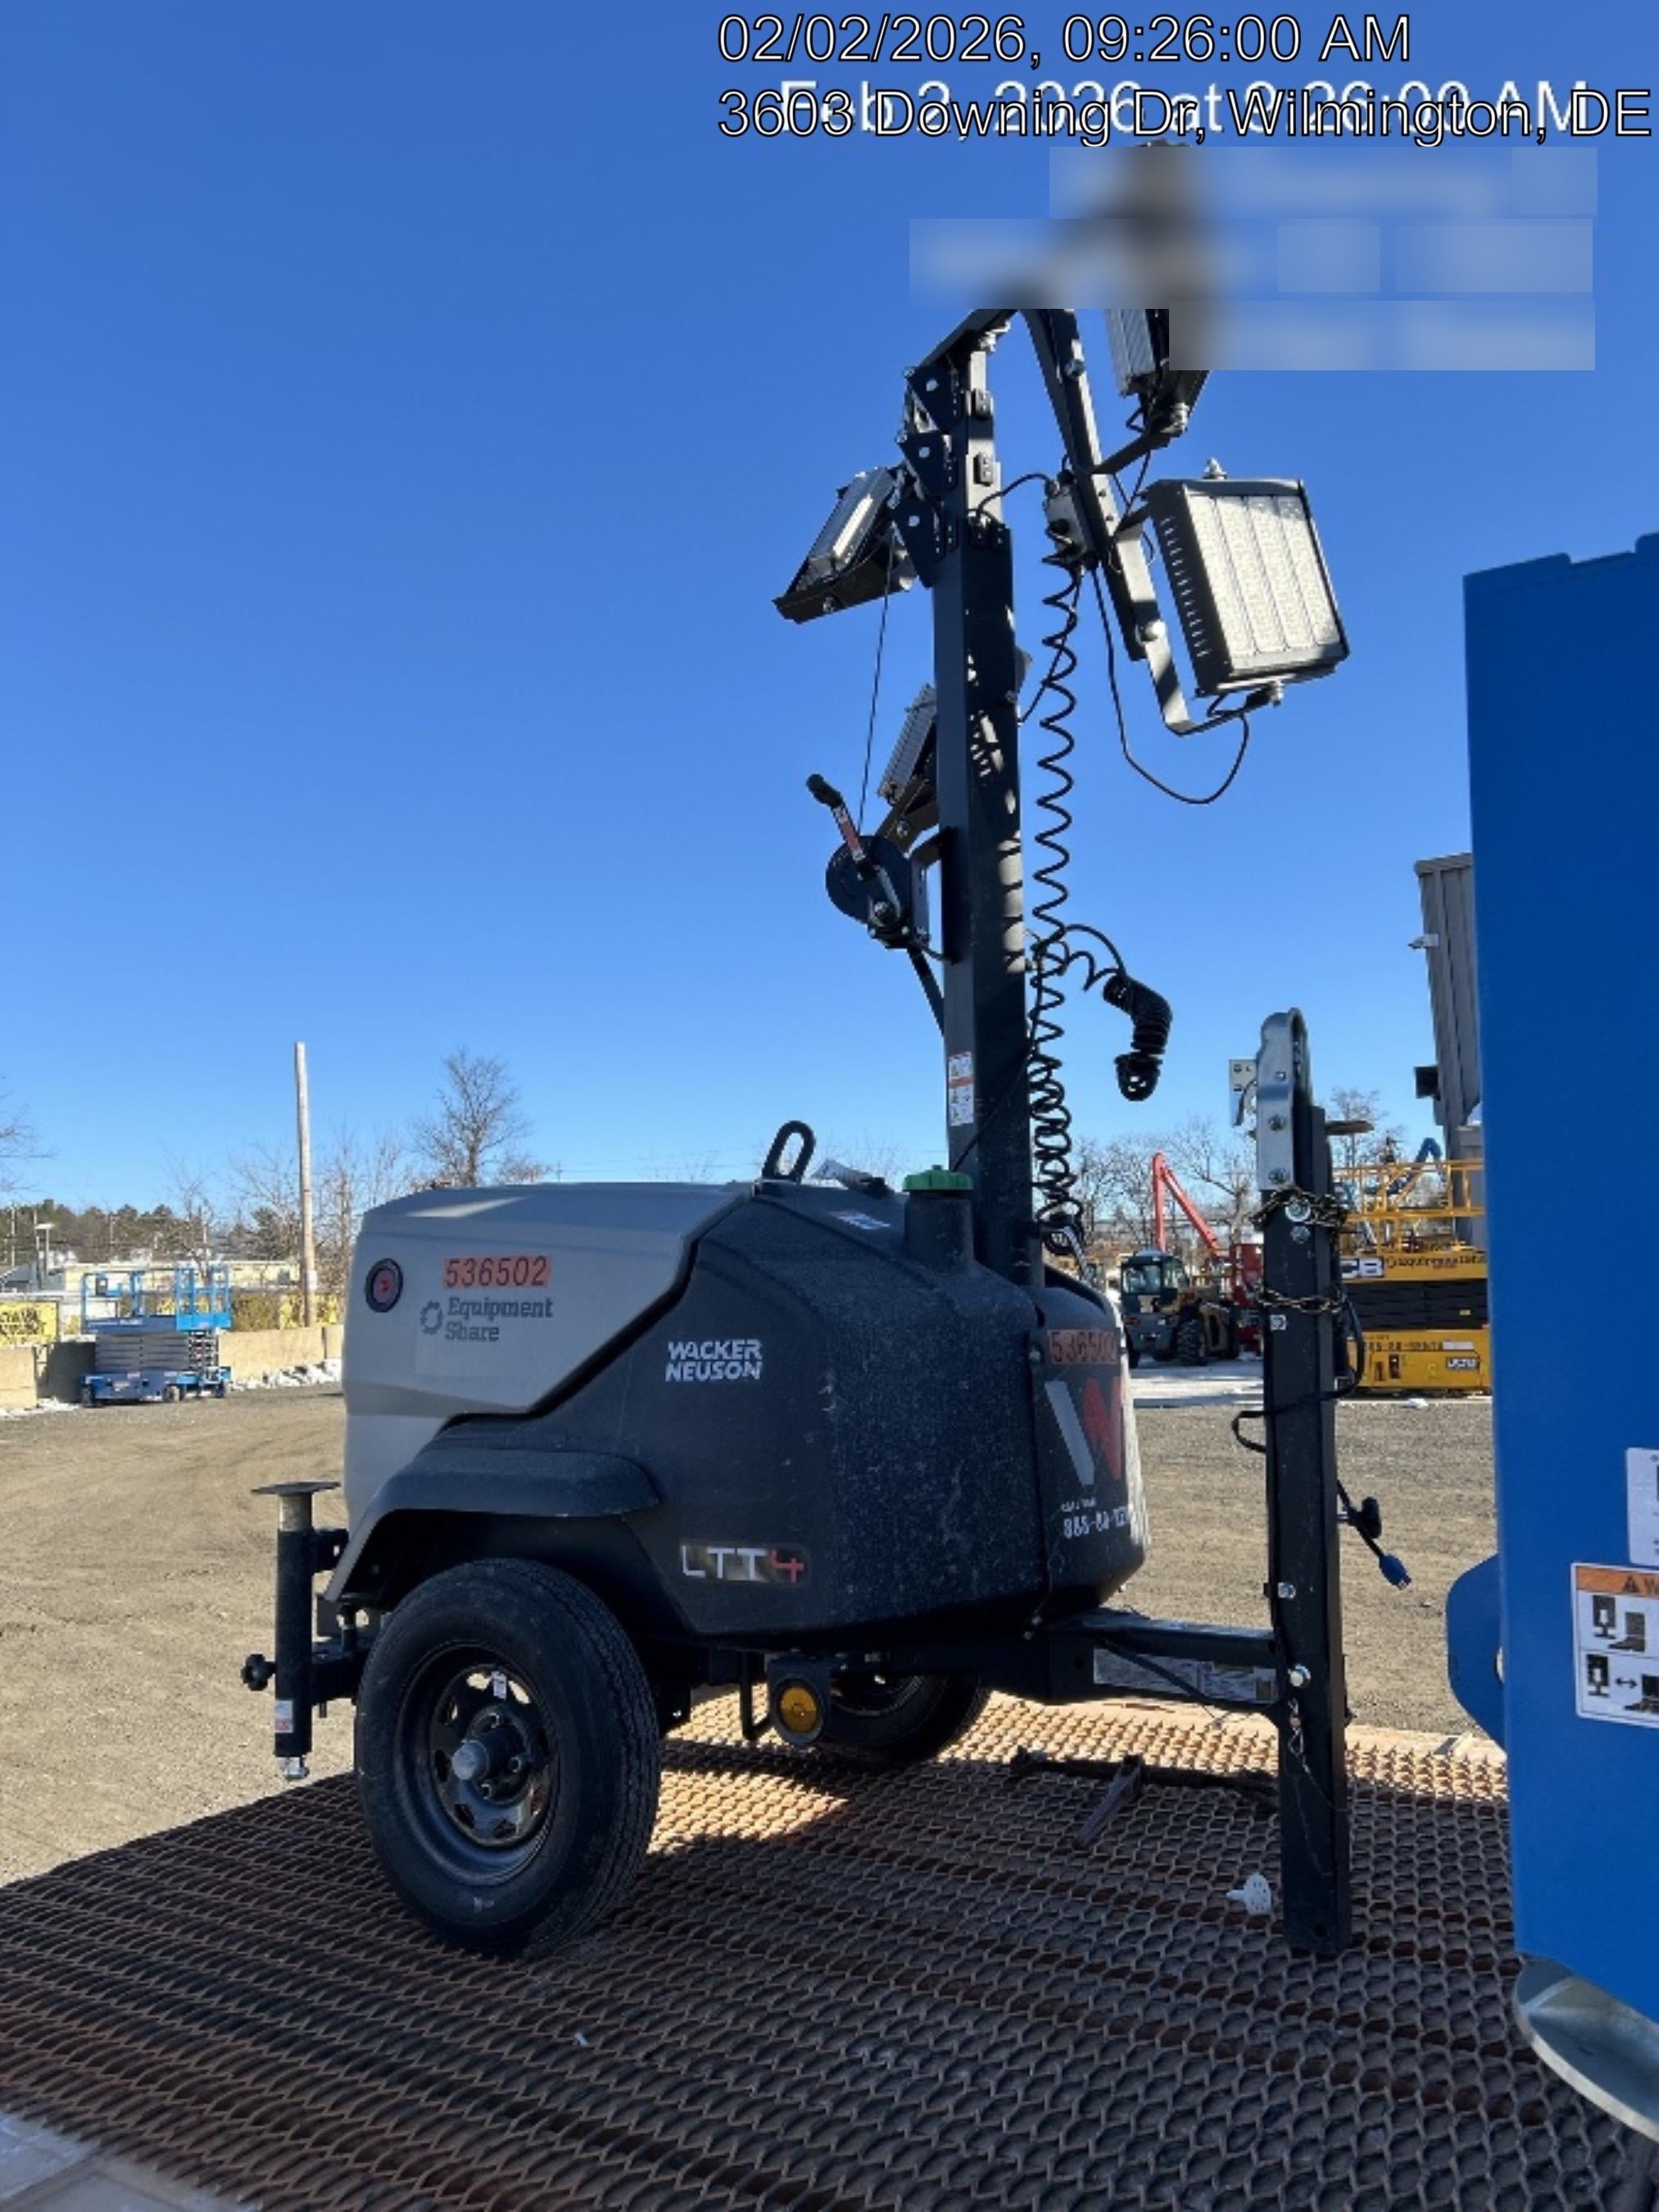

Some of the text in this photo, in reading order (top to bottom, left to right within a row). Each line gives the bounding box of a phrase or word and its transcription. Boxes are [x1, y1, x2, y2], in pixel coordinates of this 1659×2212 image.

[446, 1256, 546, 1287] 536502
[447, 1297, 554, 1321] Equipment
[446, 1321, 500, 1342] Share
[668, 1339, 762, 1360] WACKER
[665, 1361, 762, 1383] NEUSON
[682, 1545, 805, 1584] LTT4
